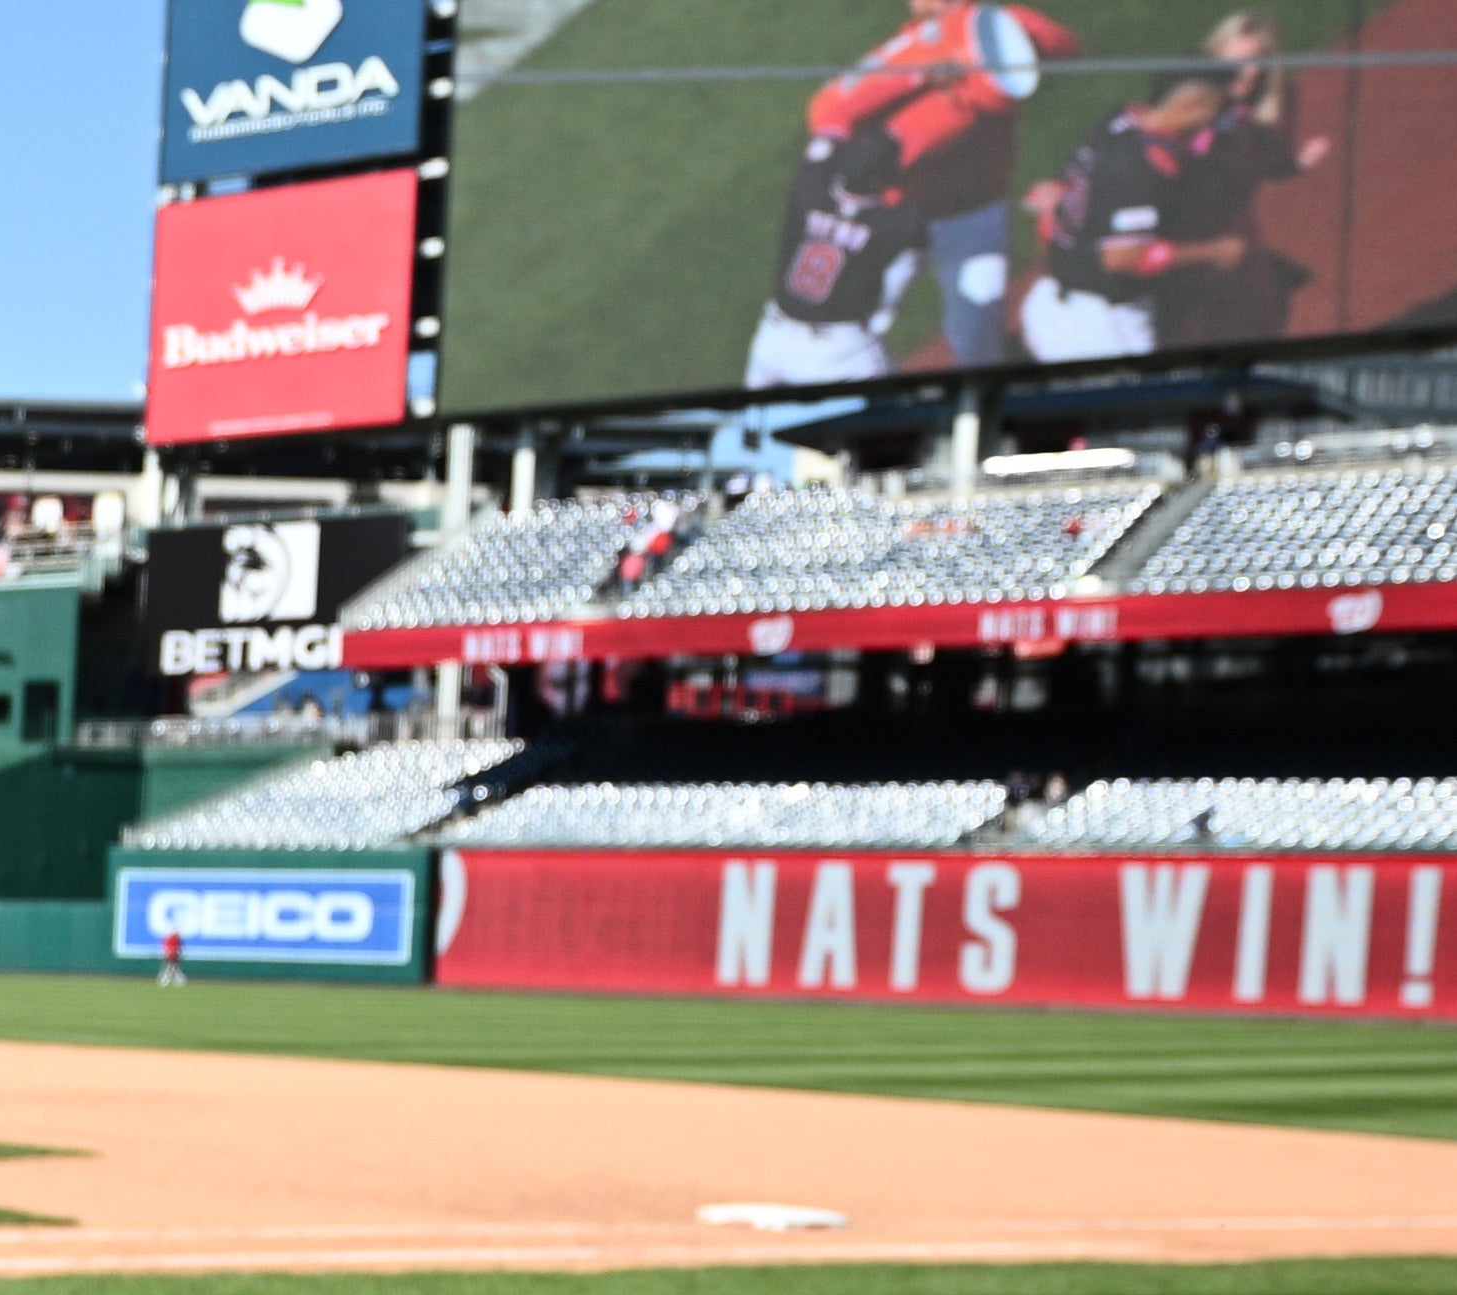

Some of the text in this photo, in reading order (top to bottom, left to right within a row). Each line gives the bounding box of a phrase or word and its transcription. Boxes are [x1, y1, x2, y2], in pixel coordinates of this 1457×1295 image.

[180, 55, 399, 128] VANDA
[162, 309, 389, 369] Budweiser
[146, 889, 376, 942] GEICO
[715, 859, 1442, 1008] NATS WIN!
